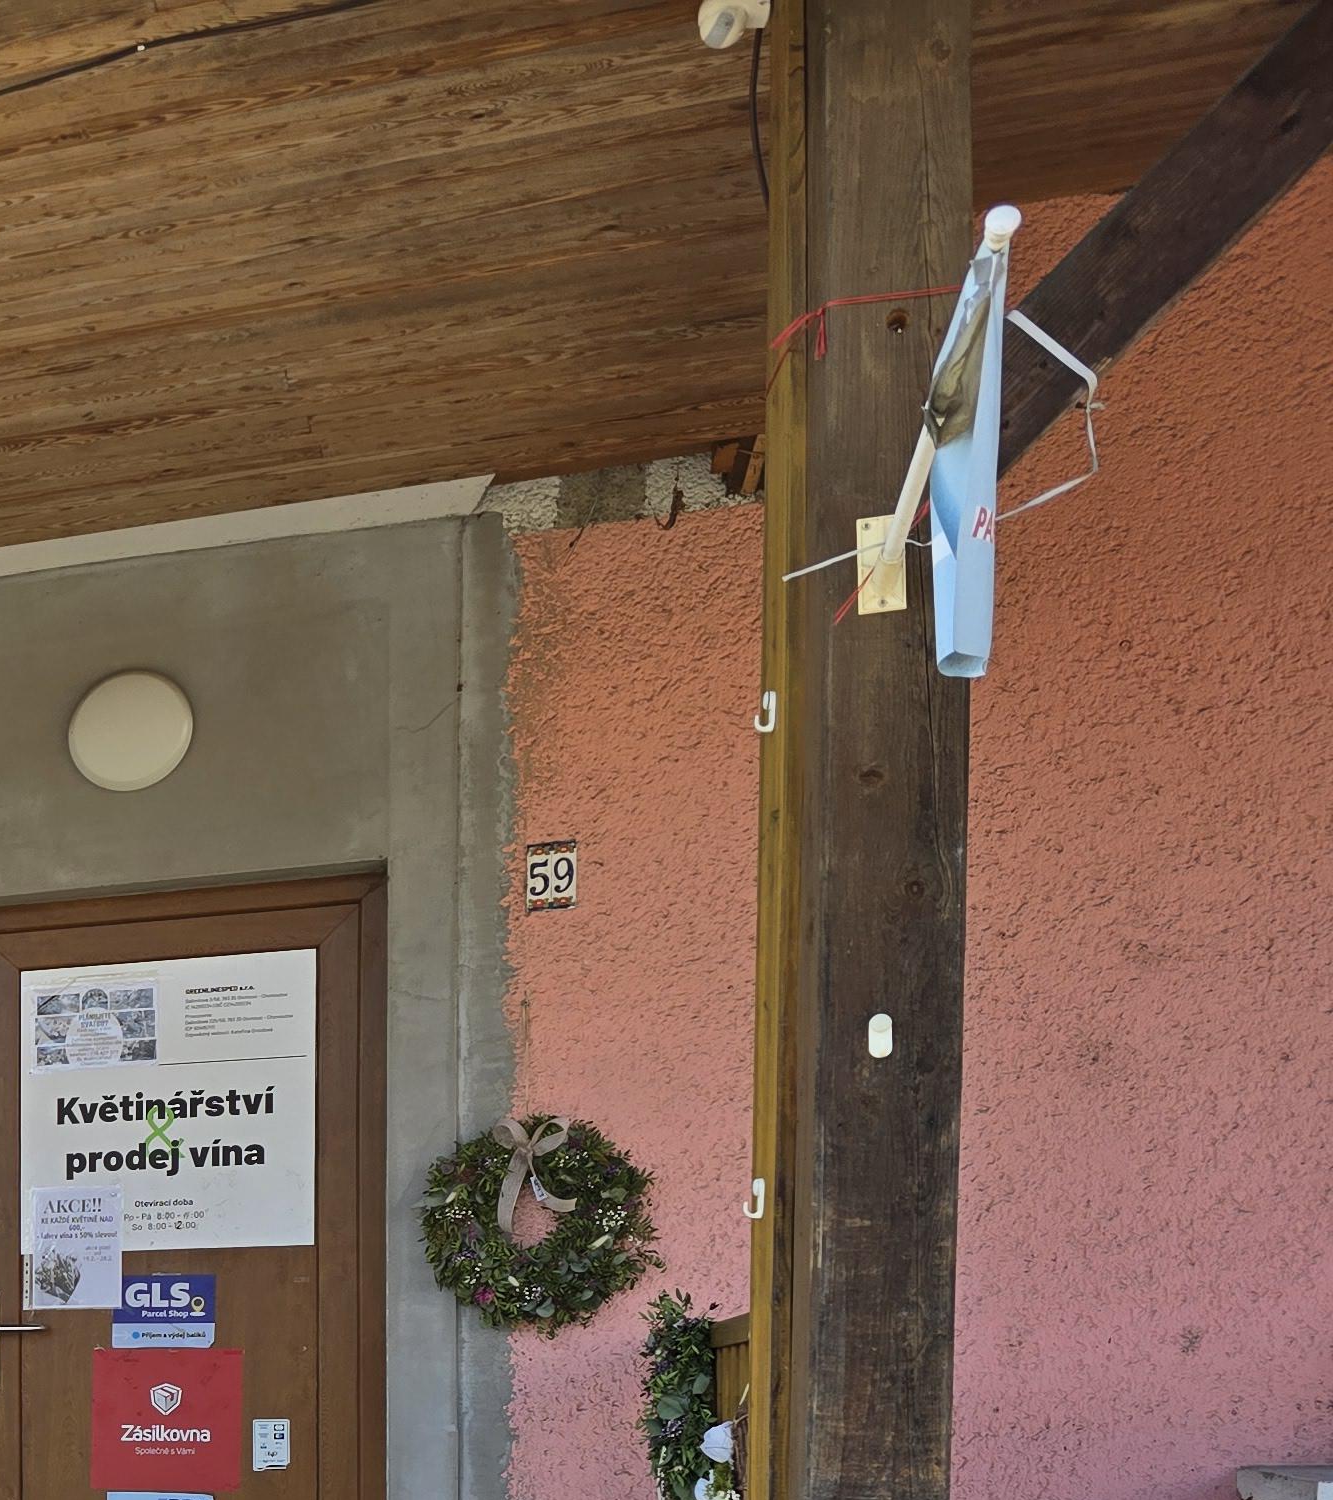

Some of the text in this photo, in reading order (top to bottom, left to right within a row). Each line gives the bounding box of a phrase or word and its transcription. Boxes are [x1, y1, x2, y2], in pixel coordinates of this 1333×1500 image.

[530, 857, 574, 896] 59
[56, 1086, 275, 1125] Květinářství
[65, 1139, 265, 1180] prodej vína
[43, 1198, 102, 1214] AKCE!!
[173, 1199, 194, 1207] doba
[125, 1282, 190, 1308] GLS
[141, 1310, 189, 1319] Parcel Shop
[120, 1424, 211, 1442] Zásilkovna
[135, 1447, 169, 1455] Společně
[176, 1447, 195, 1455] Vámi
